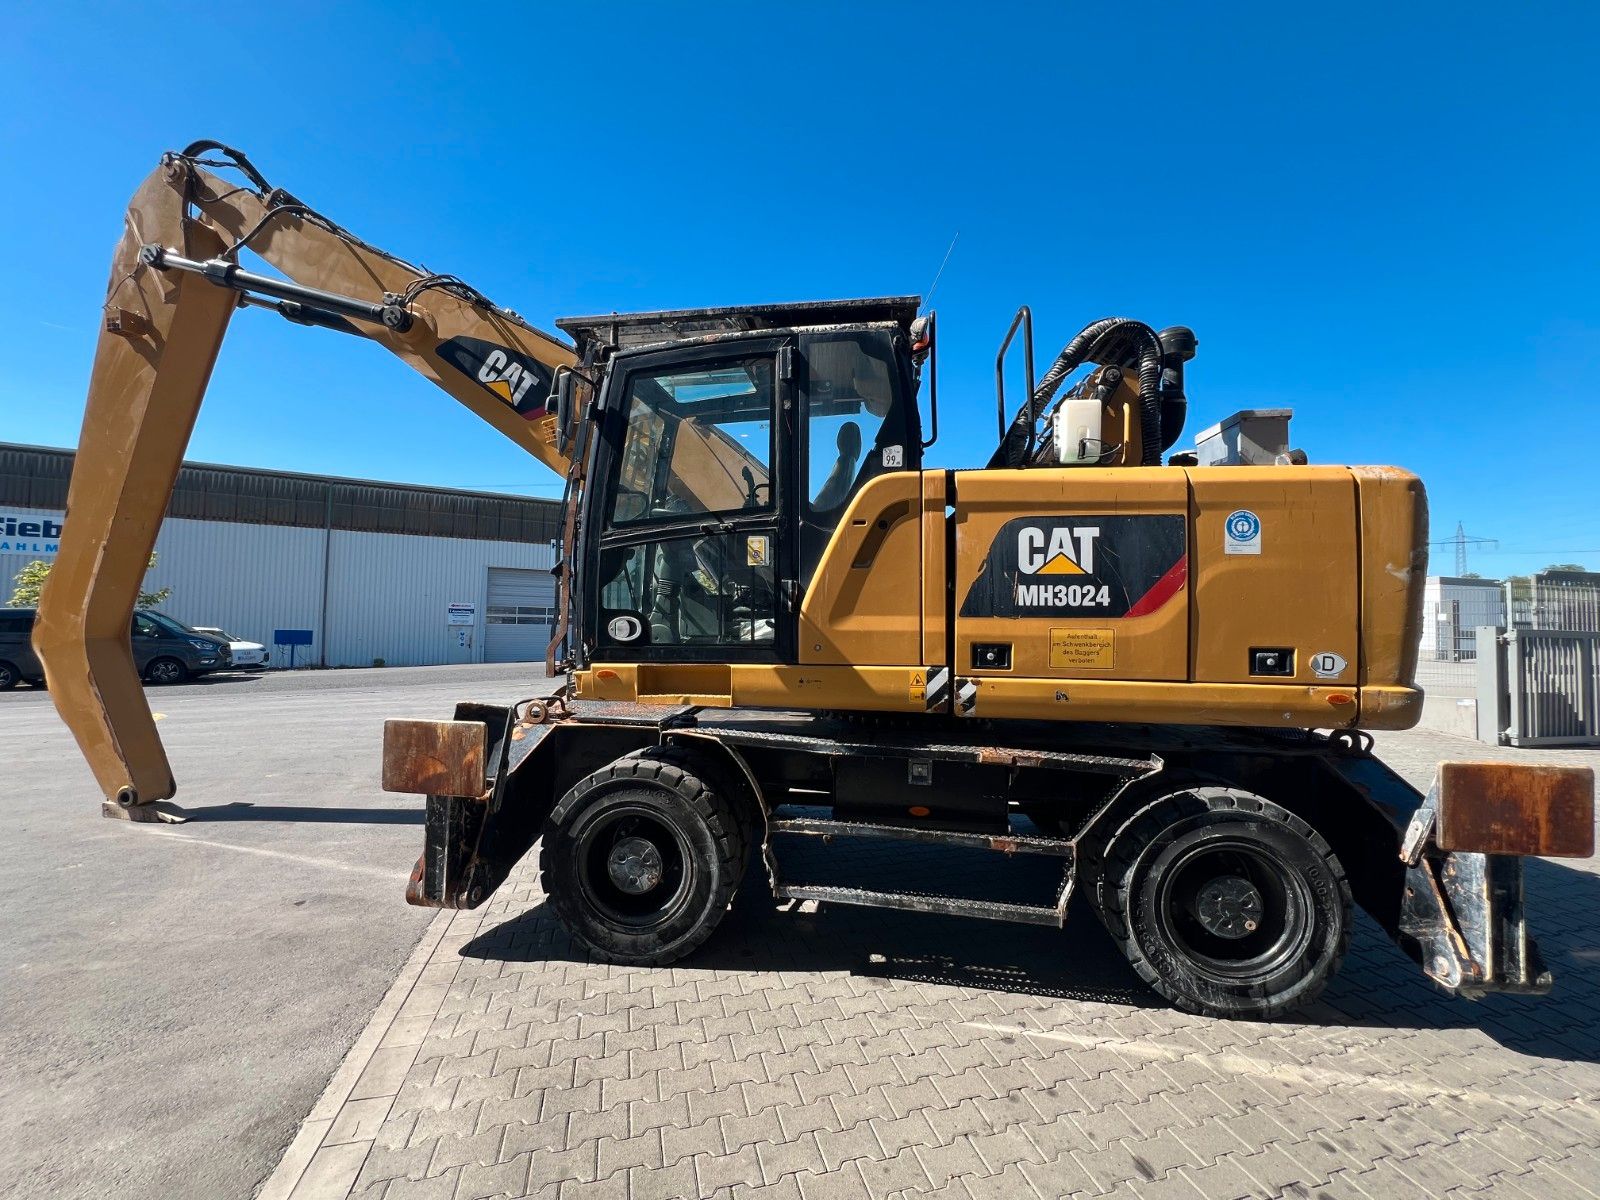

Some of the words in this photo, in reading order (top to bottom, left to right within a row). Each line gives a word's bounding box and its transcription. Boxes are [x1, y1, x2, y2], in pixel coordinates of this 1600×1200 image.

[477, 349, 540, 407] CAT
[0, 517, 62, 538] ieb
[1017, 526, 1100, 575] CAT
[1017, 584, 1111, 607] MH3024
[1322, 655, 1335, 671] D
